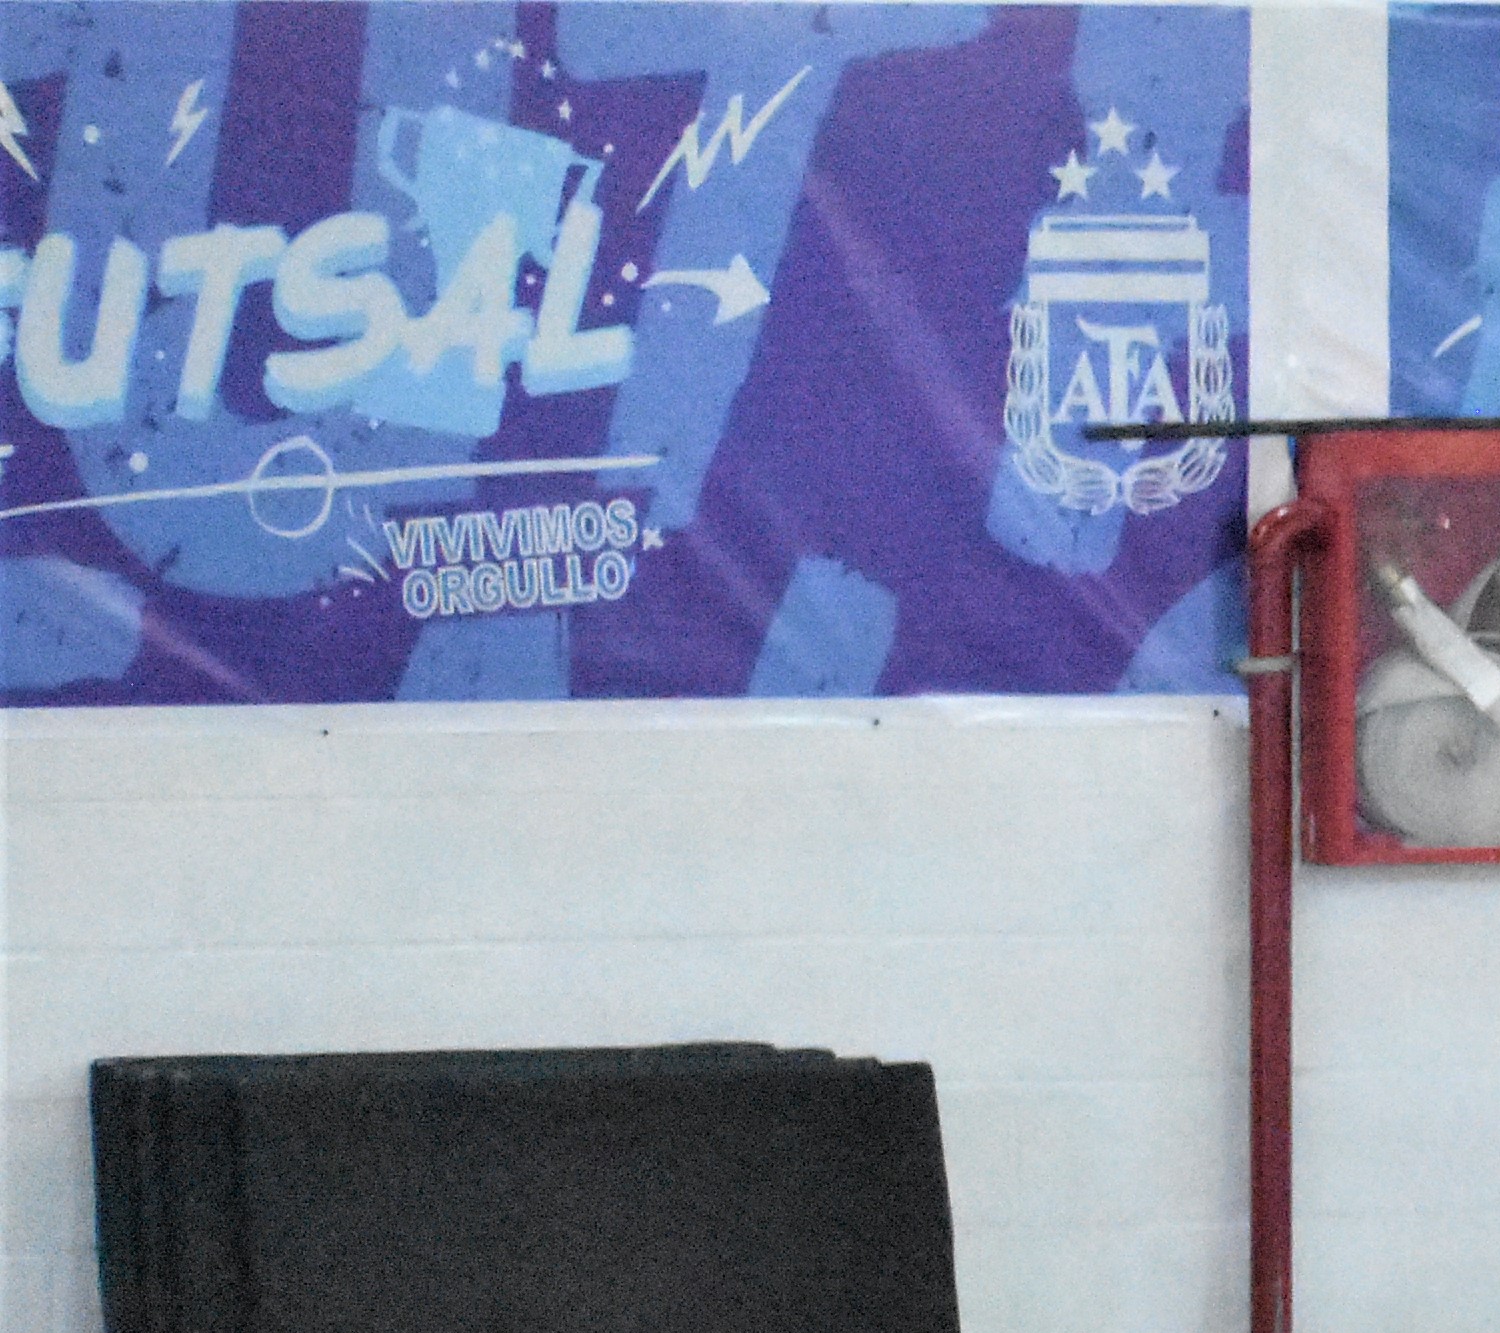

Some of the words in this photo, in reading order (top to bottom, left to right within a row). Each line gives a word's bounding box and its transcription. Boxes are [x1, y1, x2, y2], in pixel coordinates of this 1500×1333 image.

[1050, 315, 1186, 452] AFA
[382, 498, 637, 569] VIVIVIMOS
[402, 550, 630, 619] ORGULLO
